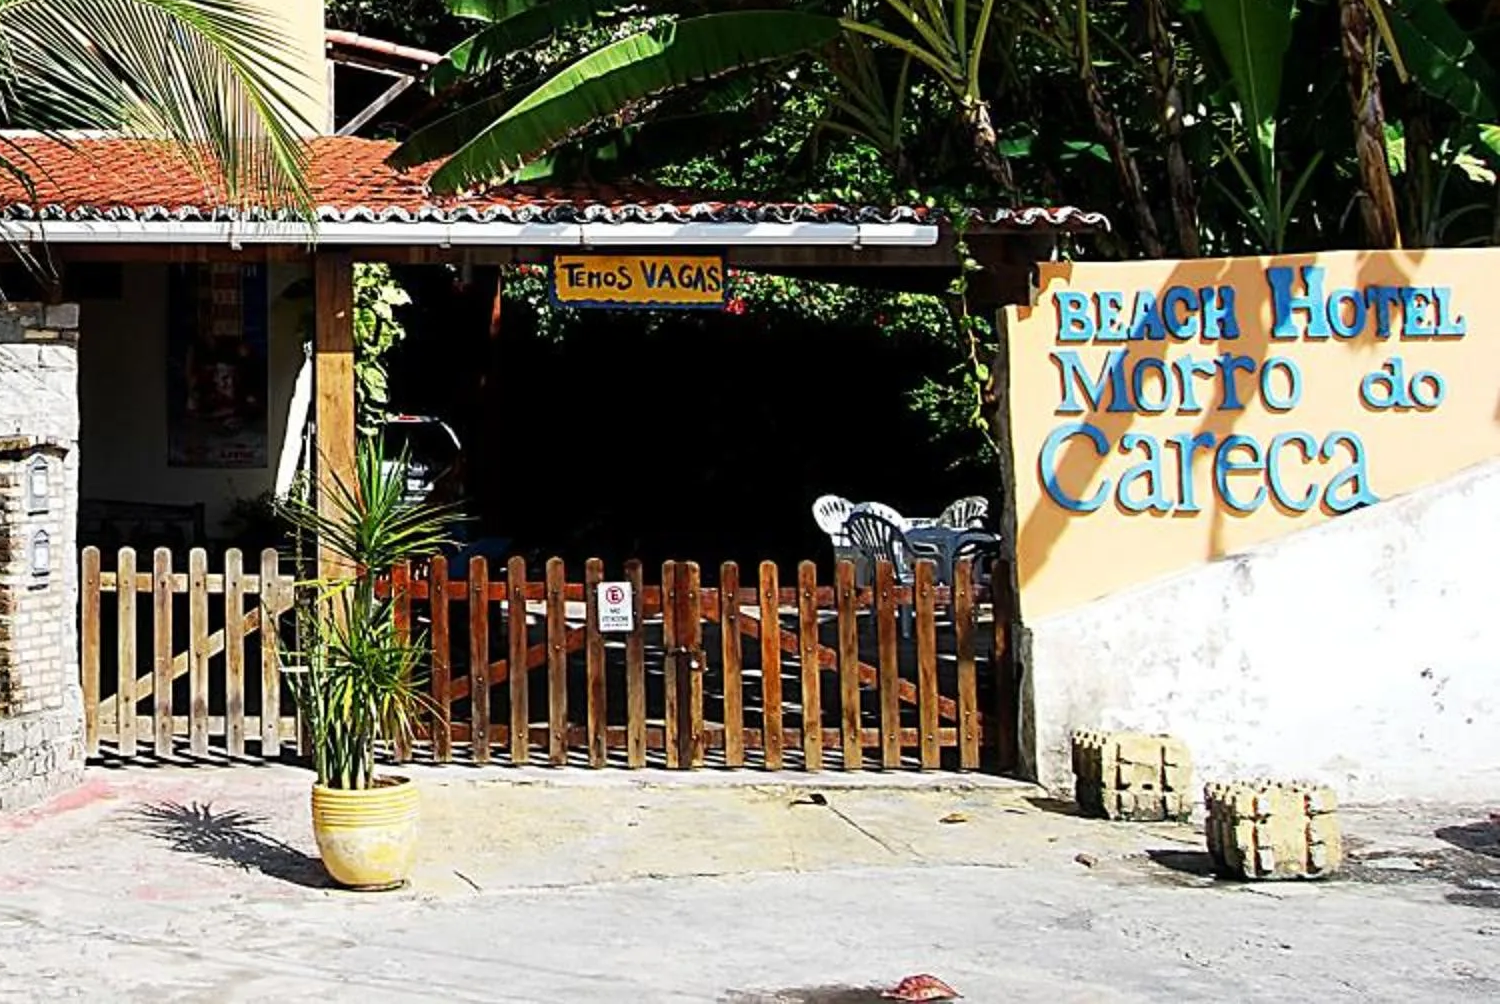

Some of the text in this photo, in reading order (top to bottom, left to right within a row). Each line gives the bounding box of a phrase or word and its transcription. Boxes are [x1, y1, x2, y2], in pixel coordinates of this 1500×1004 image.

[640, 260, 722, 292] VAGAS
[1053, 265, 1467, 342] BEACH HOTEL
[1050, 348, 1449, 416] Morro do
[1037, 421, 1382, 518] Careca
